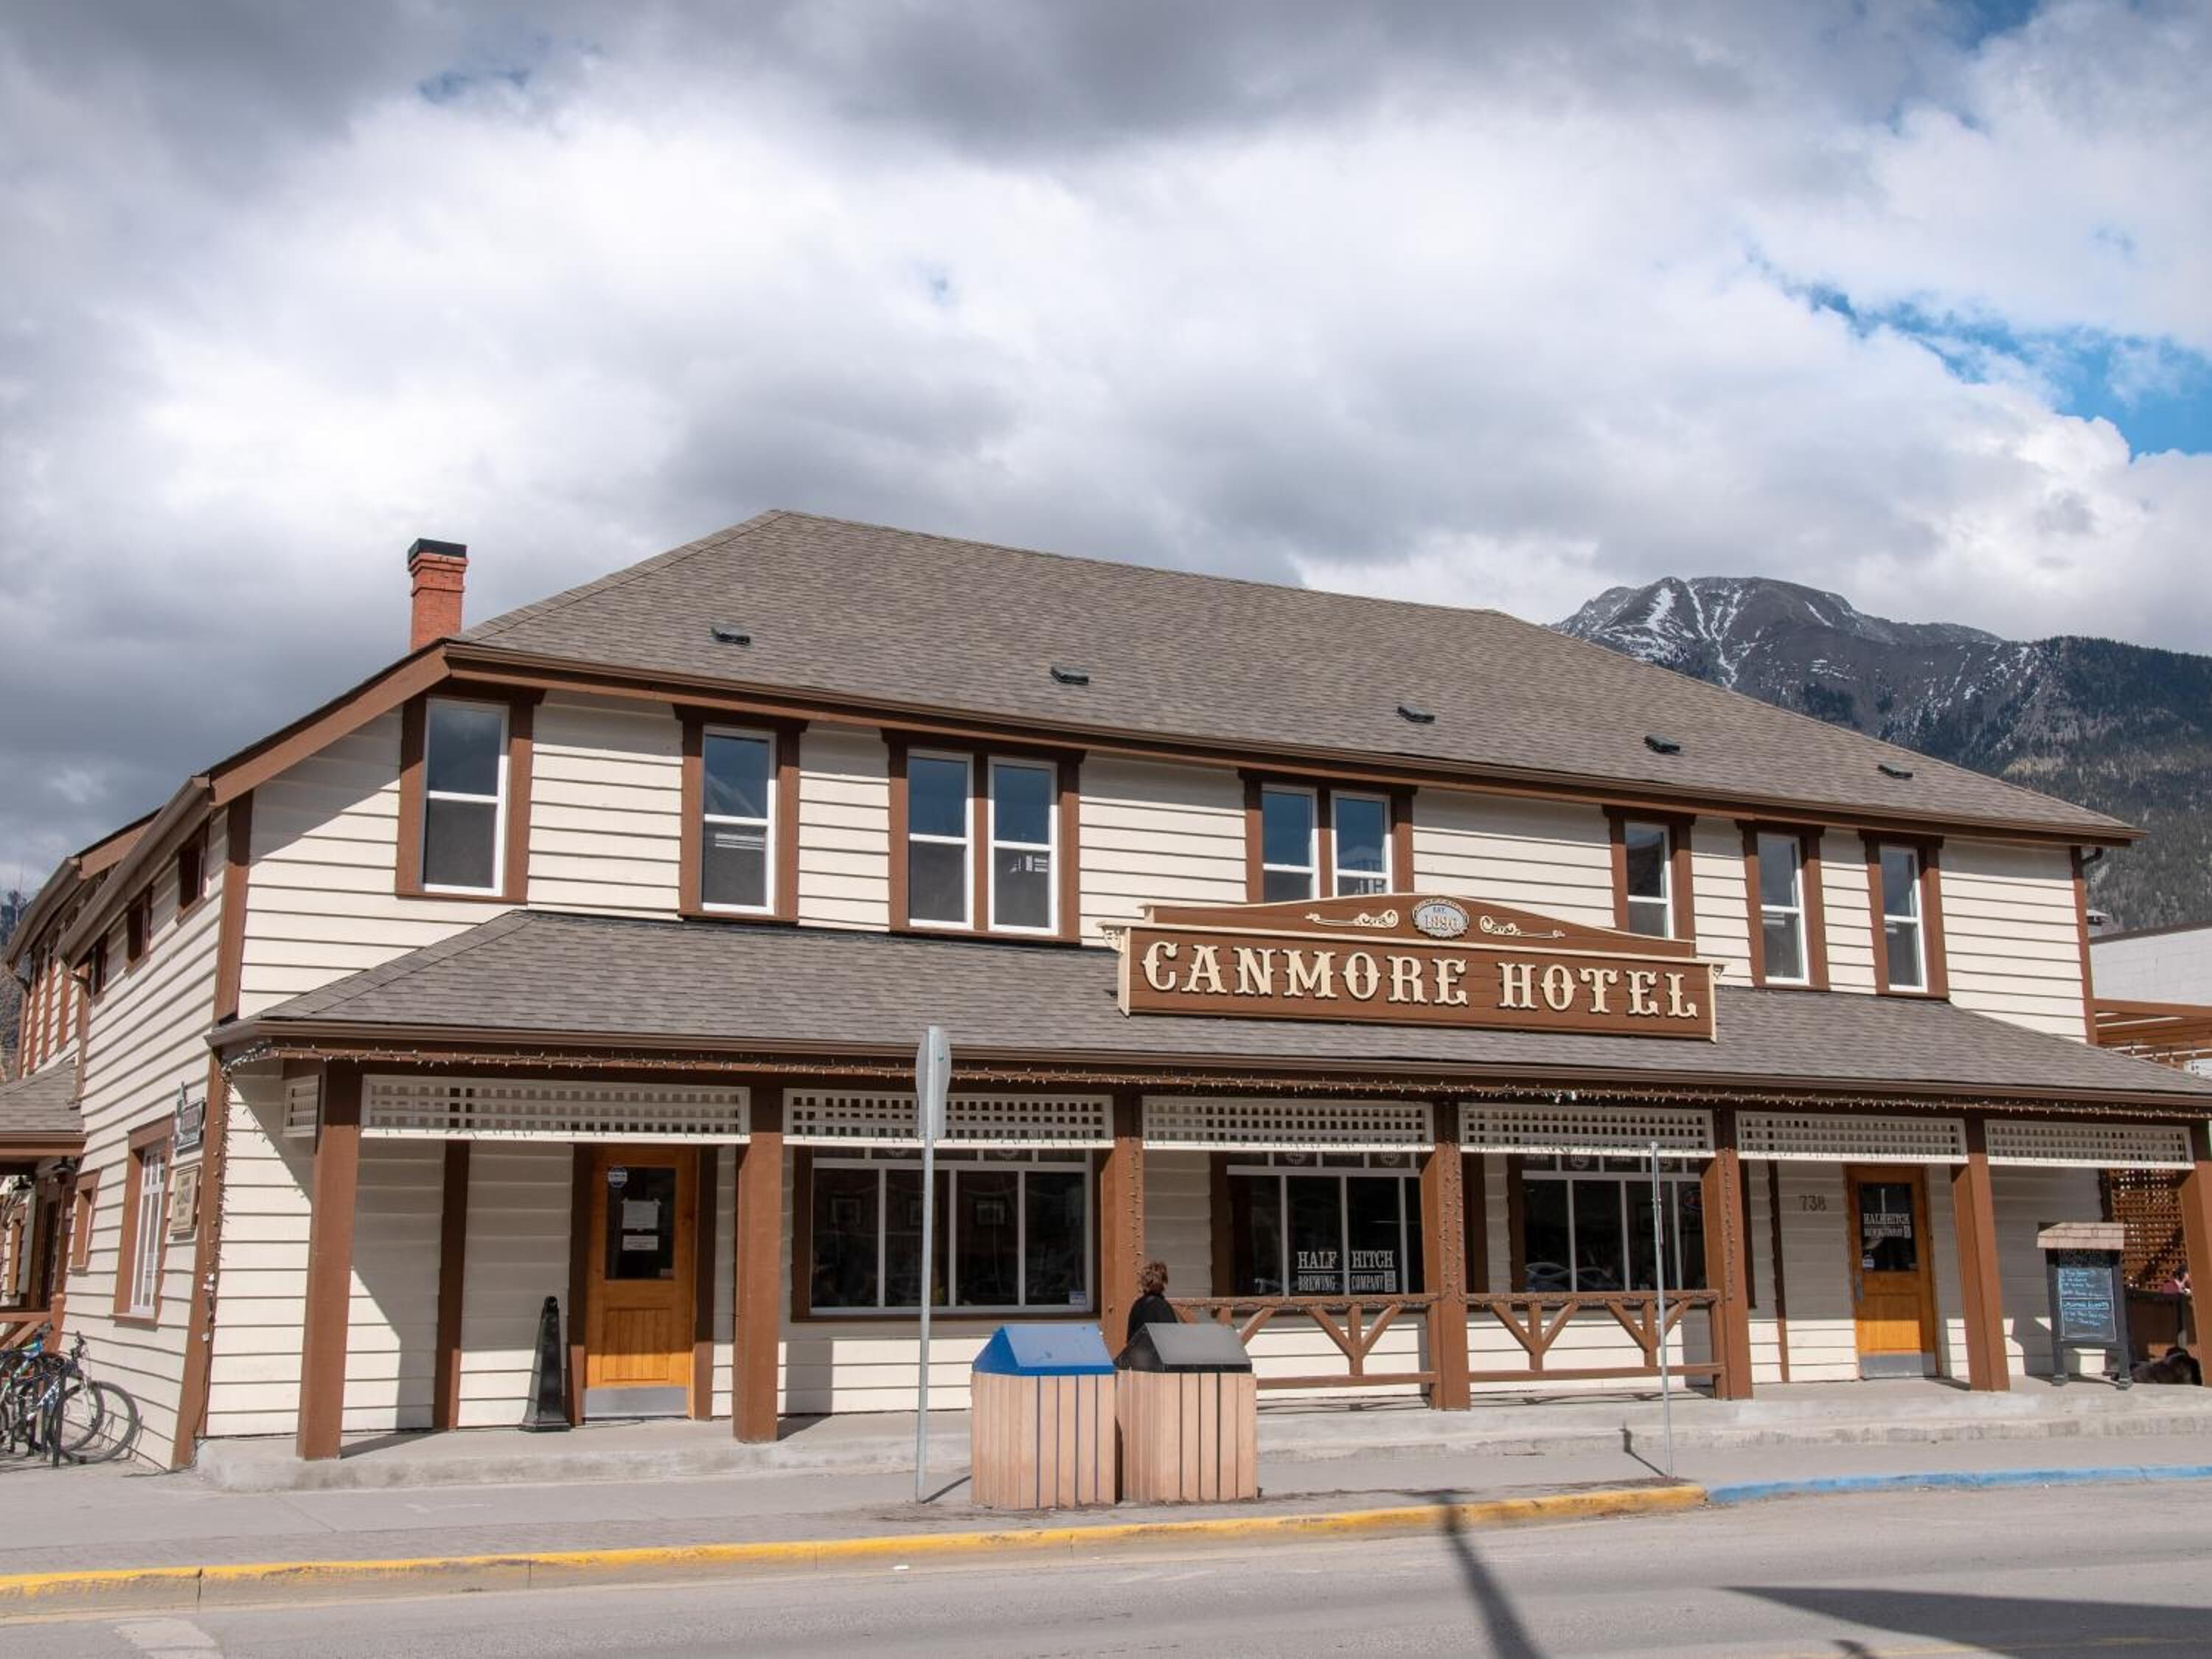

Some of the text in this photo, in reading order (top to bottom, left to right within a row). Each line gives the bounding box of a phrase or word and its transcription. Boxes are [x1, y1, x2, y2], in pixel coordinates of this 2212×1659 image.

[1141, 941, 1698, 1018] CANMORE HOTEL
[1798, 1195, 1827, 1211] 738
[1297, 1251, 1394, 1269] HALF HITCH
[1298, 1275, 1335, 1291] BREWING
[1351, 1275, 1384, 1290] COMPANY
